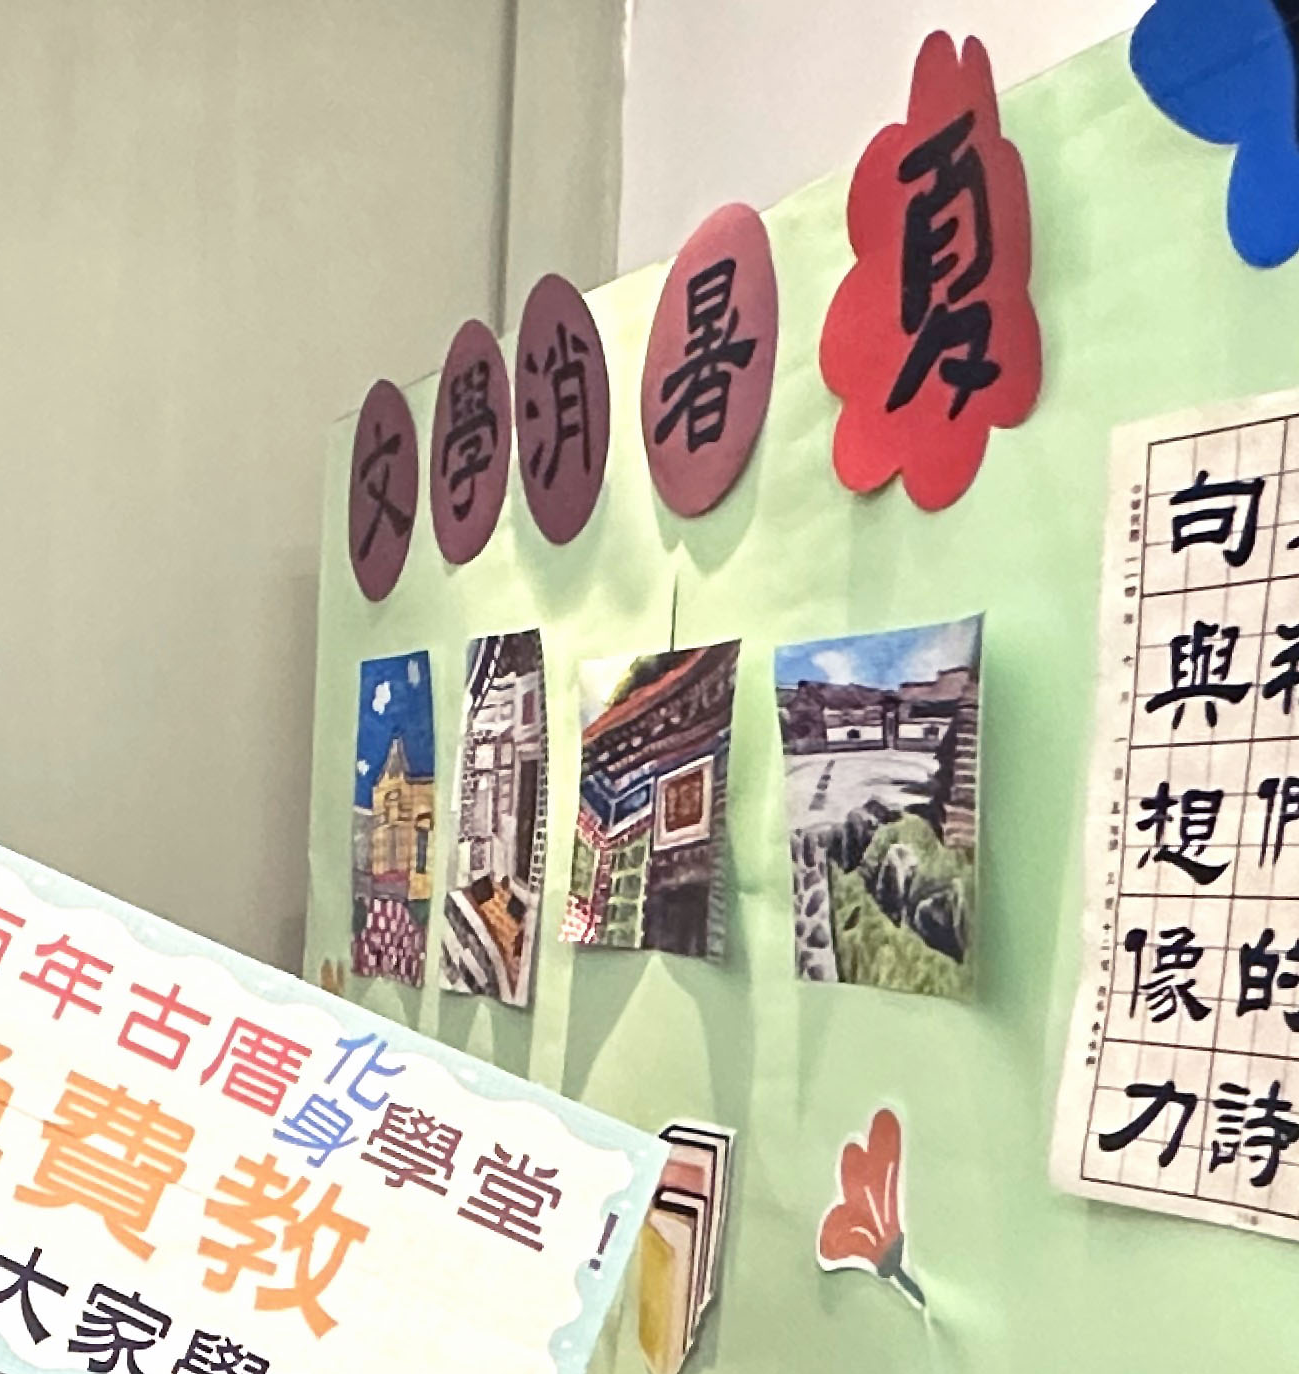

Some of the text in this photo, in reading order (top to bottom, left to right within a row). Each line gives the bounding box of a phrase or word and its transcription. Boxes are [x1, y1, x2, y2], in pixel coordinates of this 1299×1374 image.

[357, 257, 758, 561] 文學消暑
[885, 110, 1002, 421] 夏
[1098, 469, 1265, 1168] 句與想像力
